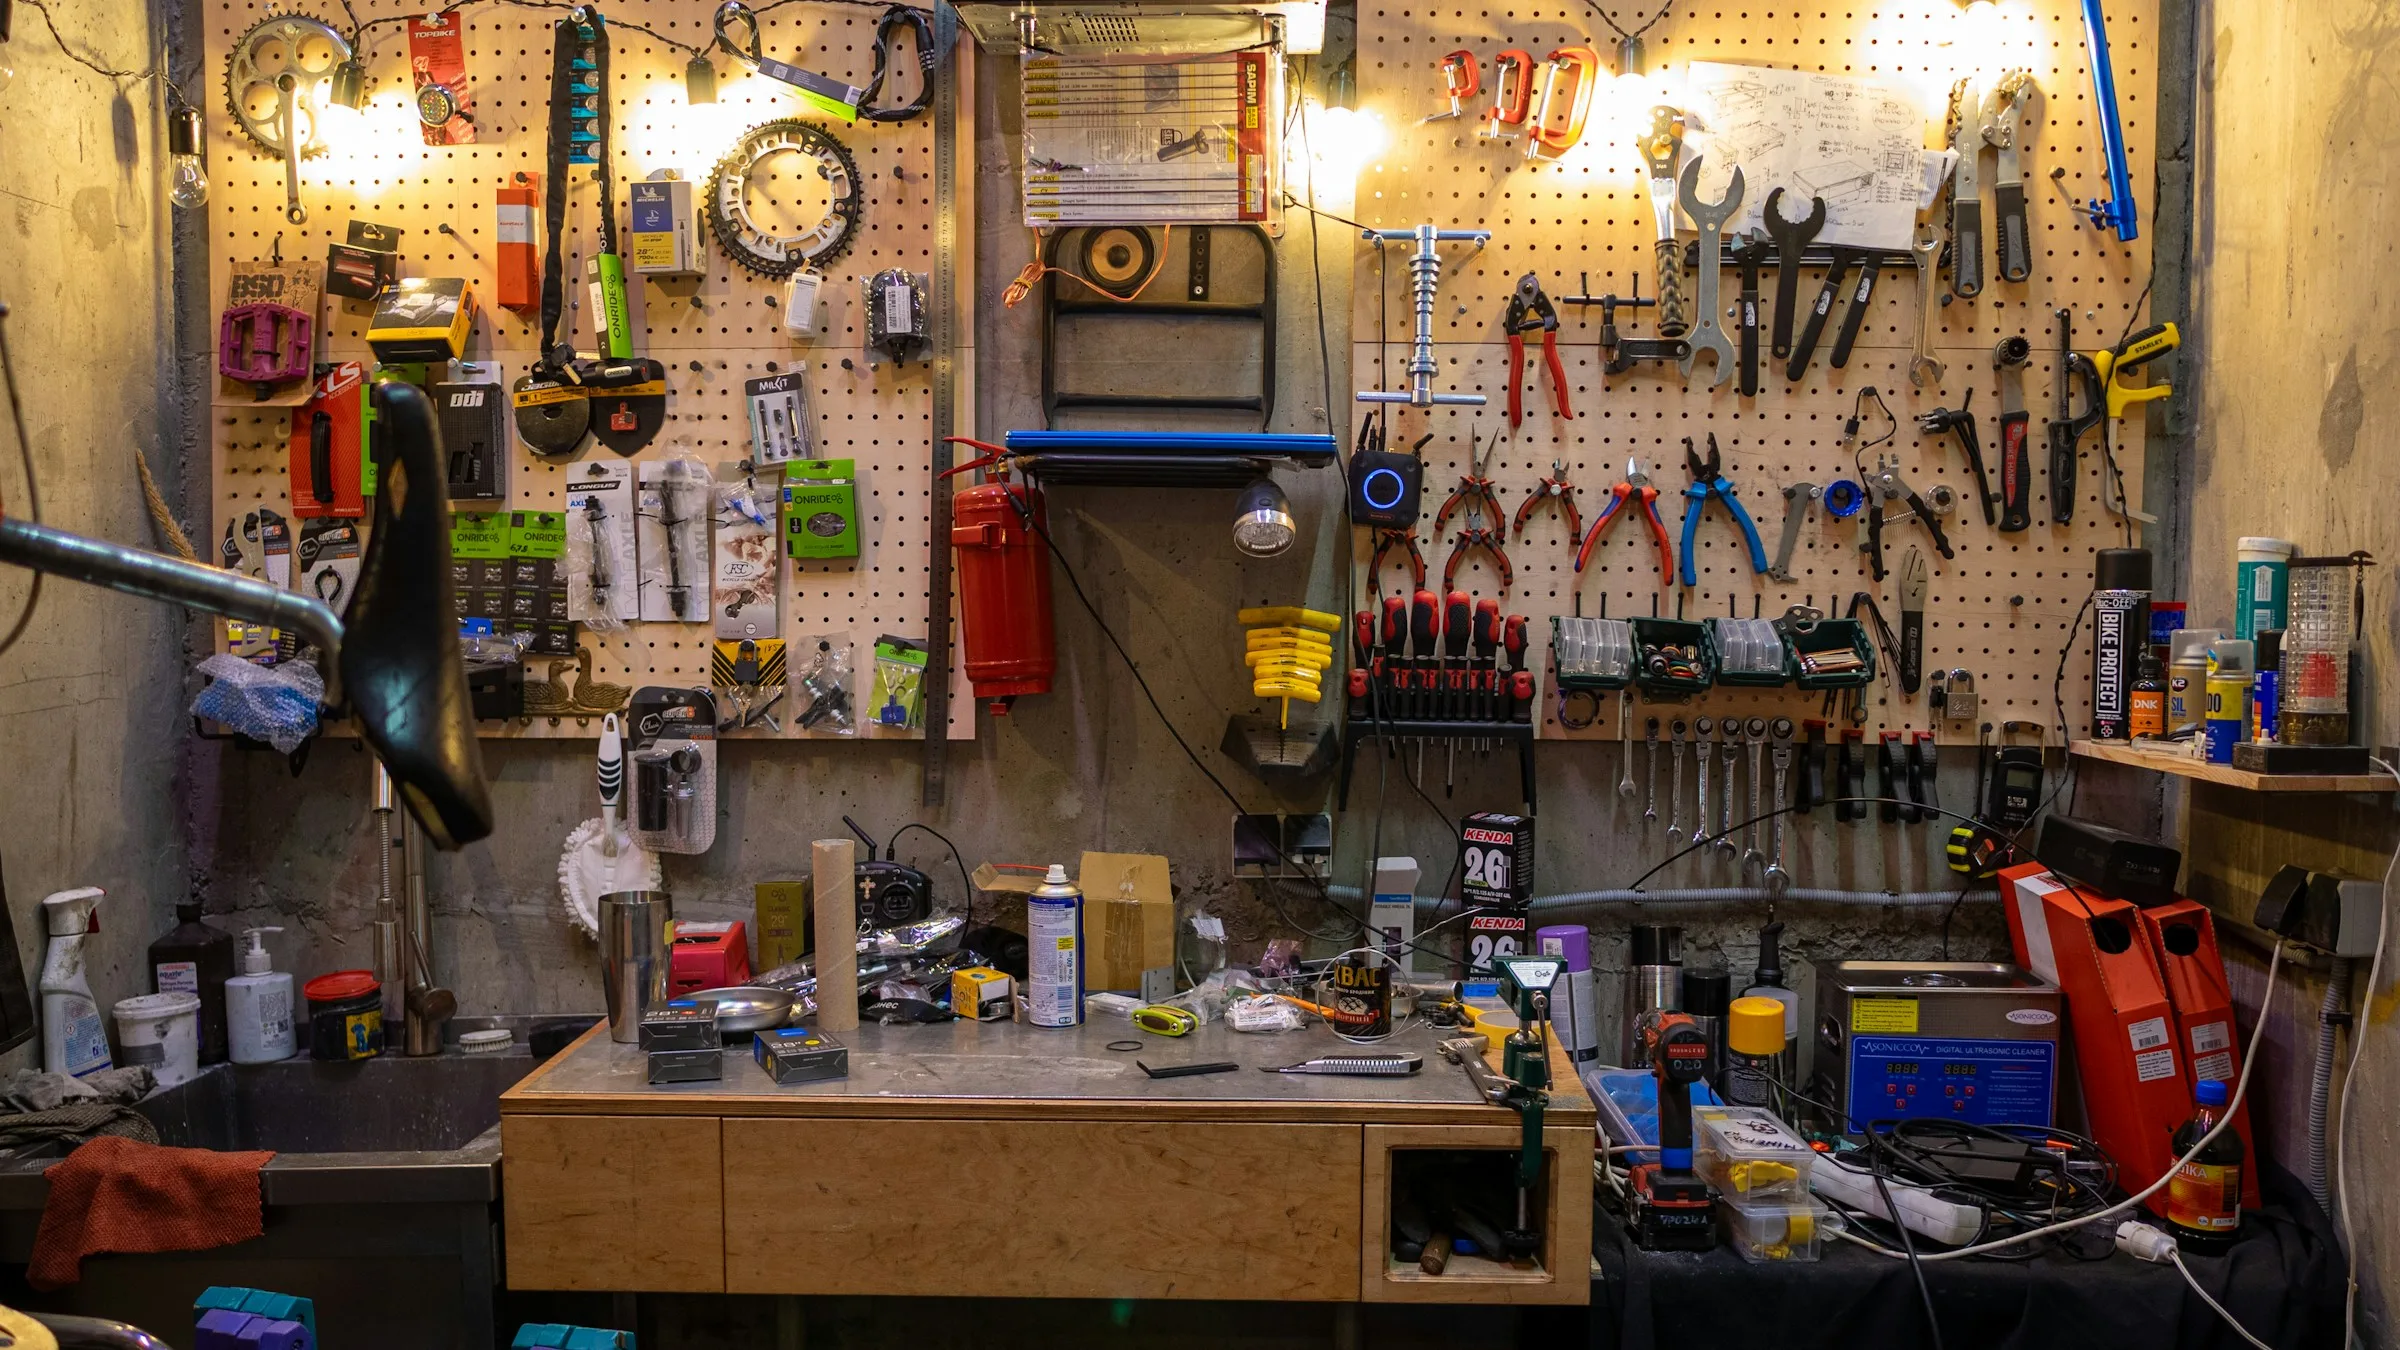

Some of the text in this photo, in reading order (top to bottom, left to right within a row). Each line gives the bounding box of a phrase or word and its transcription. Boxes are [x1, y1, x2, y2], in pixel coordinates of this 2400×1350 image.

[414, 30, 456, 38] TOPBIKE
[1246, 64, 1256, 104] SAPIM
[231, 274, 286, 298] BSD
[609, 290, 620, 339] ONRIDE
[2134, 338, 2163, 354] STANLEY
[328, 376, 362, 400] ACCESSORIES
[760, 377, 788, 391] MILKIT
[795, 495, 831, 504] ONRIDE
[457, 533, 488, 542] ONRIDE
[524, 532, 558, 543] ONRIDE
[2100, 614, 2118, 710] BIKE PROTECT
[2172, 679, 2185, 688] K2
[2134, 699, 2157, 709] DNK
[2171, 697, 2186, 711] SIL
[1464, 828, 1513, 845] KENDA
[1464, 847, 1504, 890] 26
[1471, 917, 1526, 930] KENDA
[1965, 1047, 2010, 1055] ULTRASONIC
